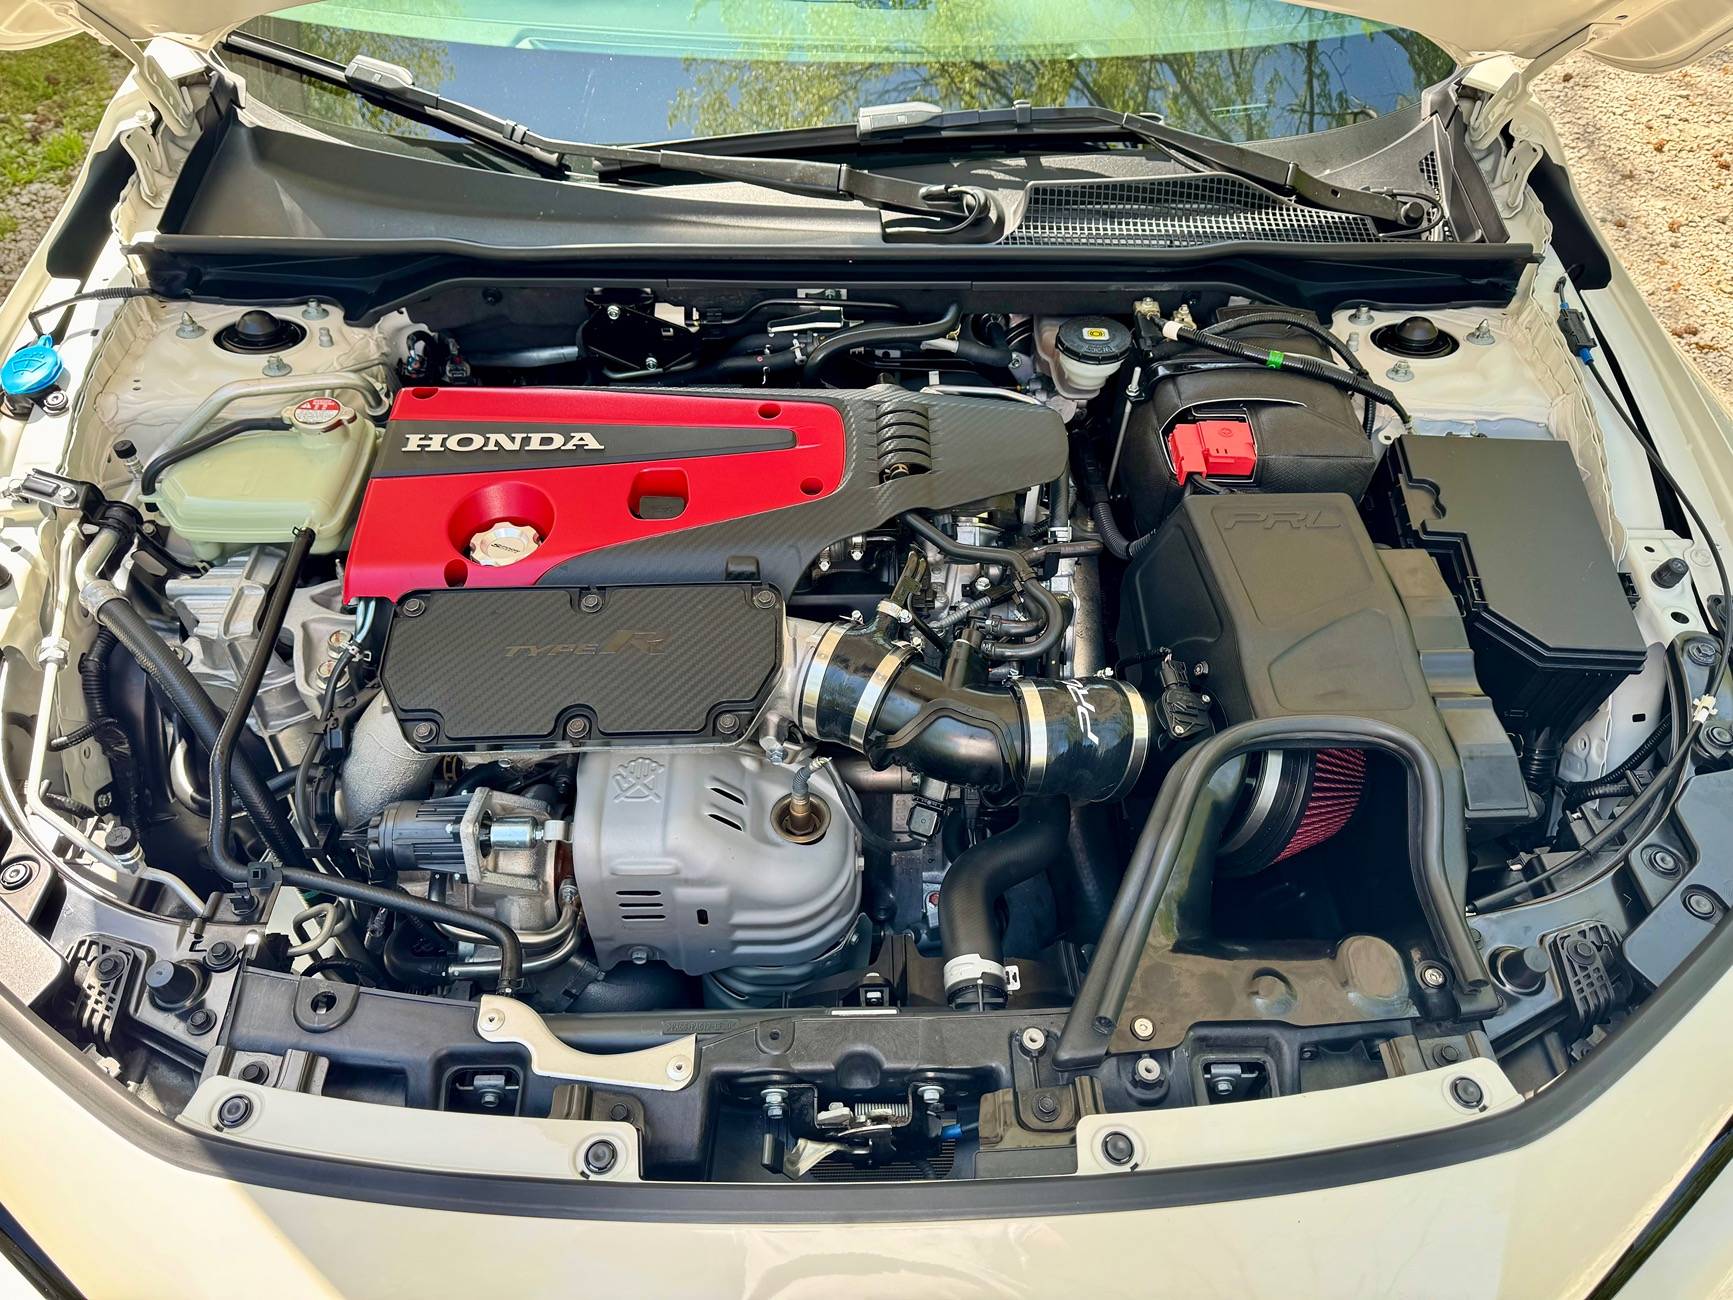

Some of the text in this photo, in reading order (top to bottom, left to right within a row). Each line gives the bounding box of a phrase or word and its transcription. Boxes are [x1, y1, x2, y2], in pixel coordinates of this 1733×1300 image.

[401, 432, 605, 452] HONDA
[1224, 510, 1344, 530] PRL
[504, 629, 673, 657] TYPE R
